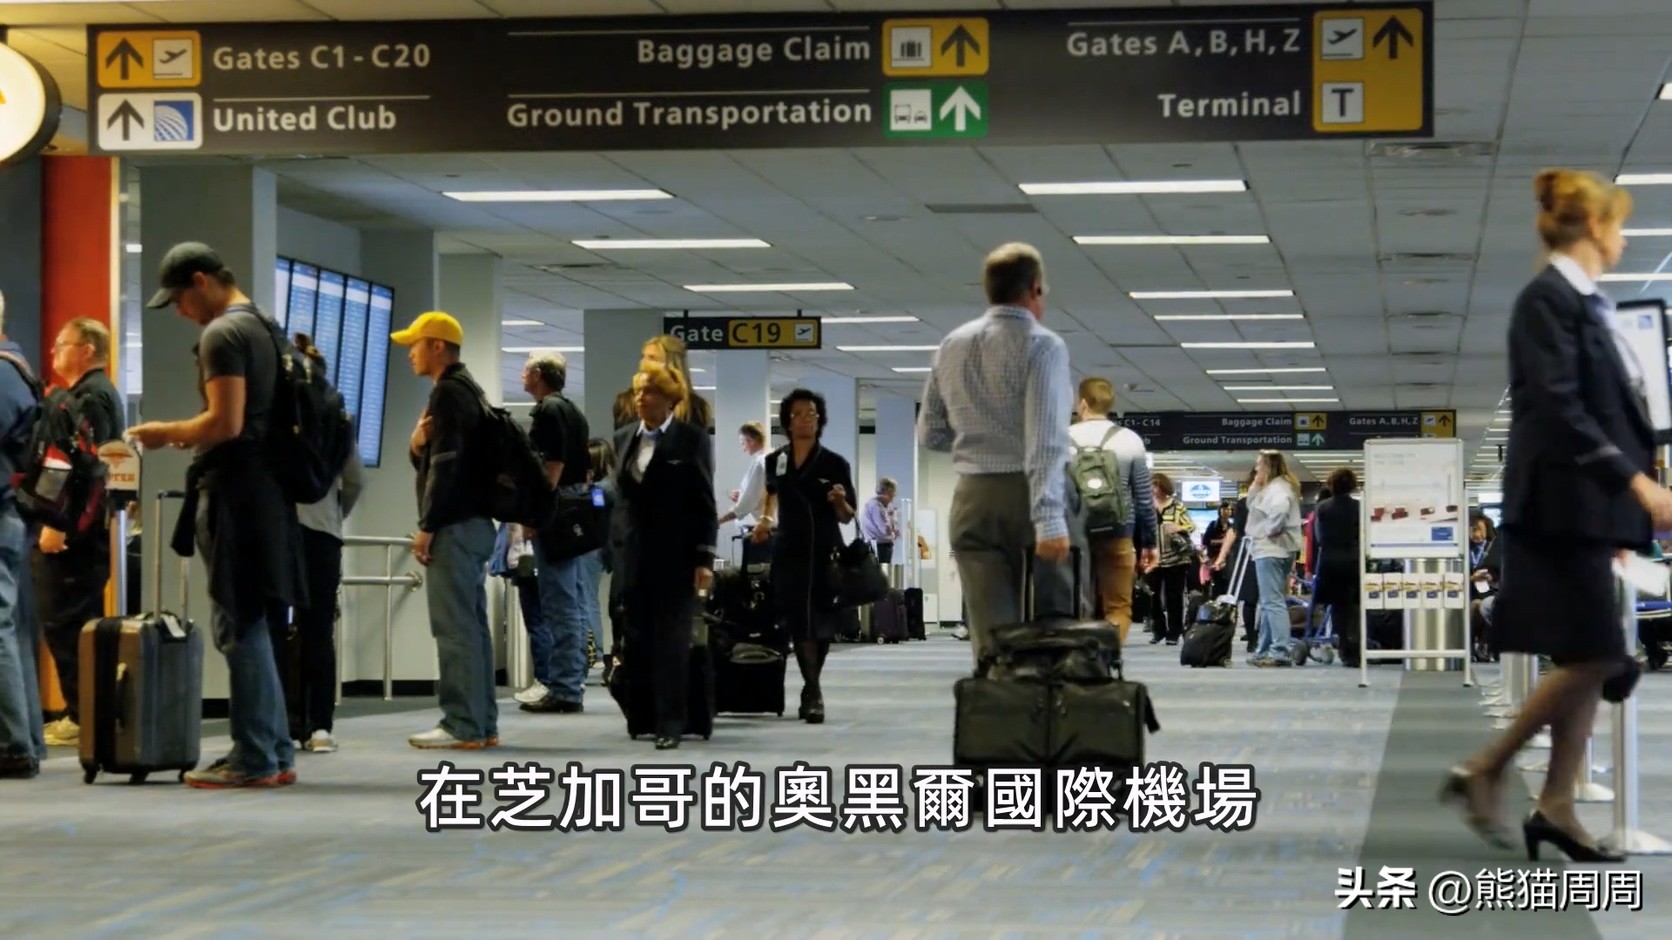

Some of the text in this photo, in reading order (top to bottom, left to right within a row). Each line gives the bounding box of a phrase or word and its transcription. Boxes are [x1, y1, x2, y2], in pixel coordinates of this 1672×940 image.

[637, 35, 871, 68] Baggage Claim
[1066, 31, 1158, 57] Gates
[212, 45, 301, 71] Gates
[506, 98, 872, 132] Ground Transportation
[1157, 90, 1300, 118] Terminal
[213, 104, 397, 133] United Club
[670, 322, 781, 344] Gate C19
[1221, 416, 1292, 428] Baggage Claim
[1349, 416, 1376, 426] Gates
[1182, 434, 1292, 445] Ground Transportation
